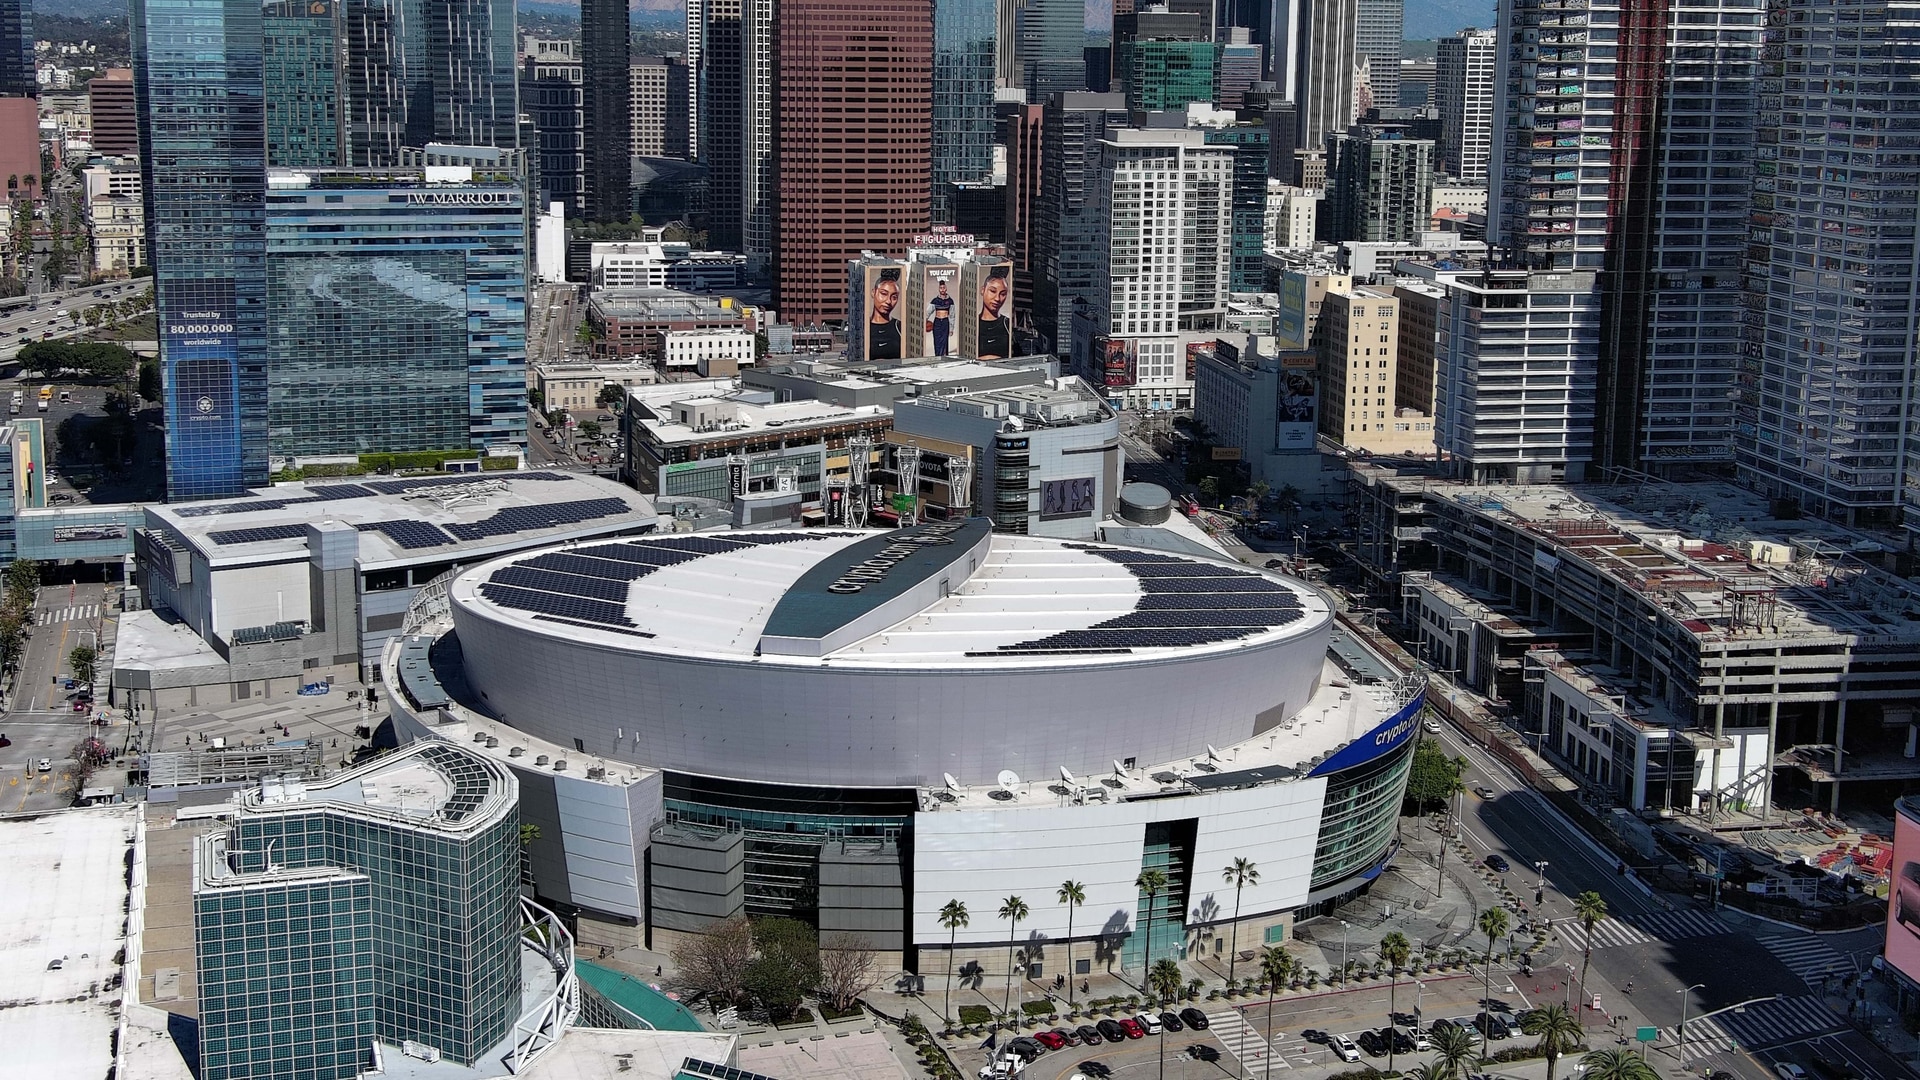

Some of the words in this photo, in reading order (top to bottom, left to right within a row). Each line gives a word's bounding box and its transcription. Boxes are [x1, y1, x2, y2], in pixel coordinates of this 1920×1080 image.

[405, 193, 428, 207] JW
[432, 192, 514, 205] MARRIOTT
[914, 234, 974, 244] FIGUEROA
[171, 324, 233, 334] 80,000,000
[919, 461, 942, 473] OYOTA
[828, 543, 922, 592] crypto.com
